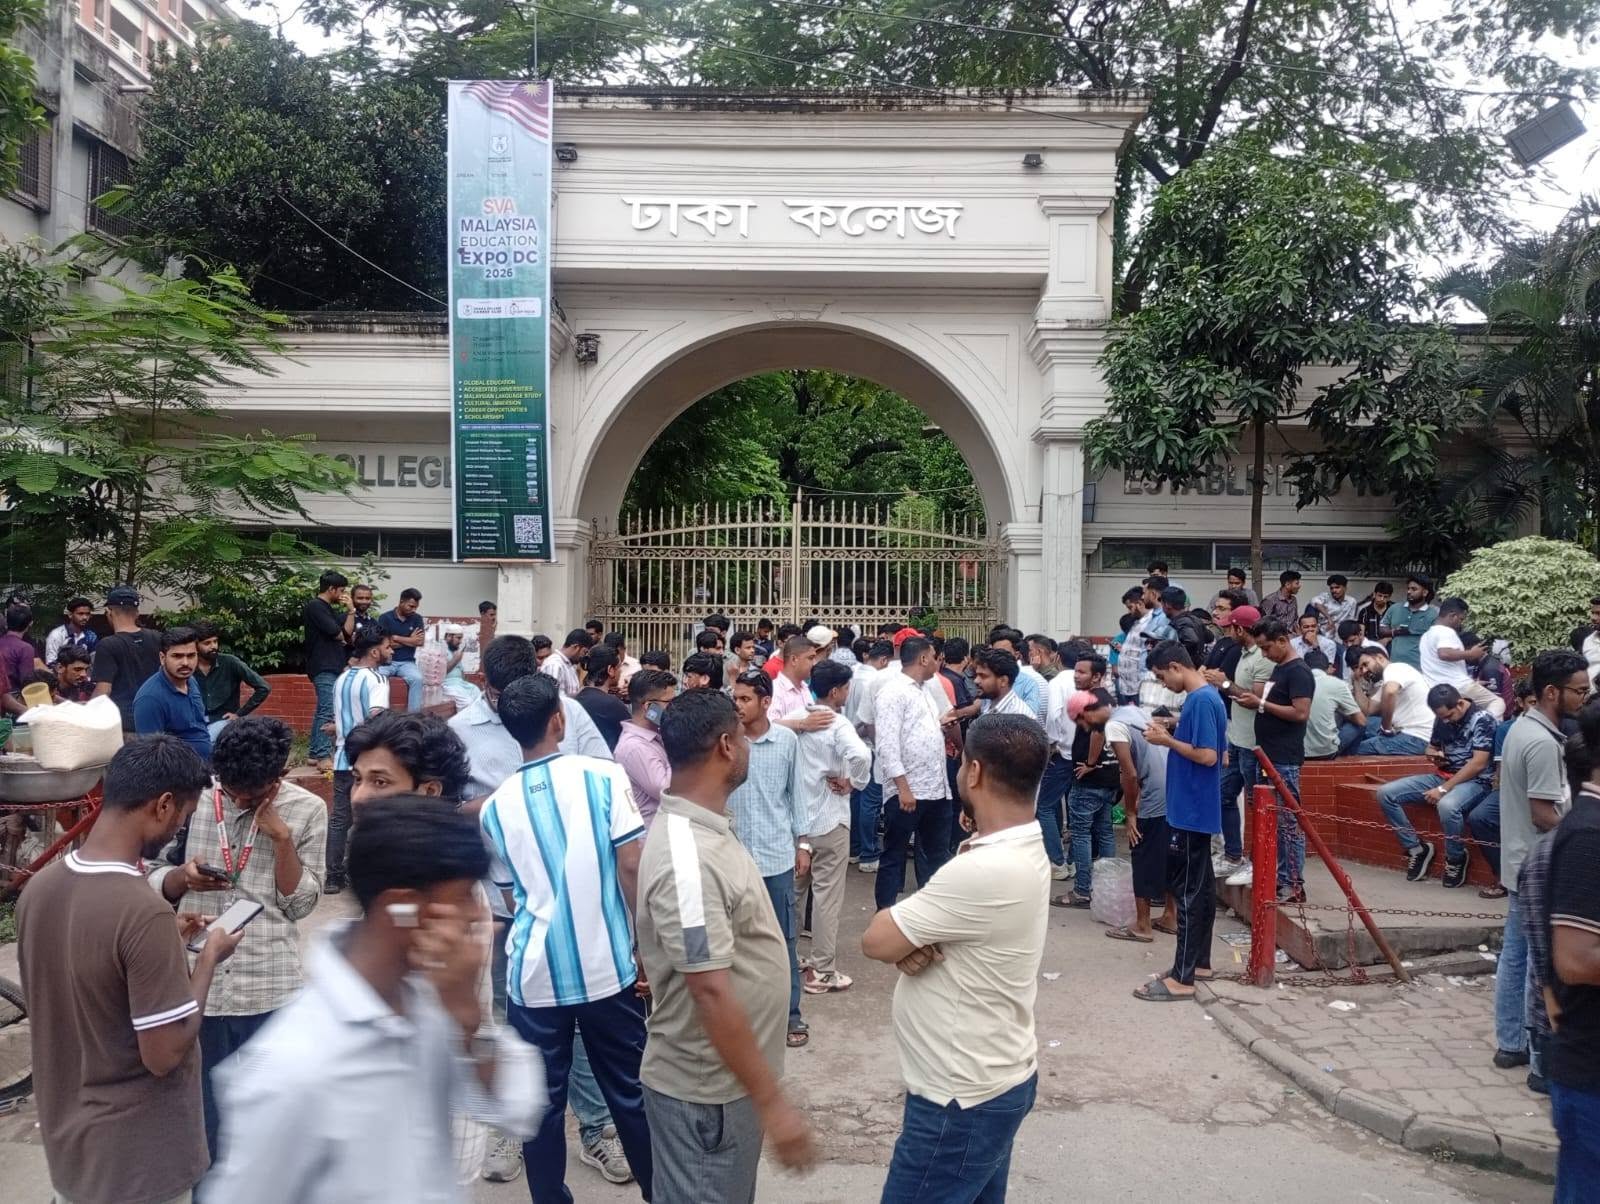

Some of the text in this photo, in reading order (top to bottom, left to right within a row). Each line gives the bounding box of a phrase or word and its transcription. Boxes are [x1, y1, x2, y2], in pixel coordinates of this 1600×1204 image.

[483, 198, 514, 215] SVA
[460, 218, 537, 232] MALAYSIA
[621, 197, 964, 238] ঢাকা কলেজ
[460, 235, 538, 247] EDUCATION
[460, 250, 538, 266] EXPO DC
[485, 268, 513, 279] 2026
[311, 453, 452, 488] OLLEG
